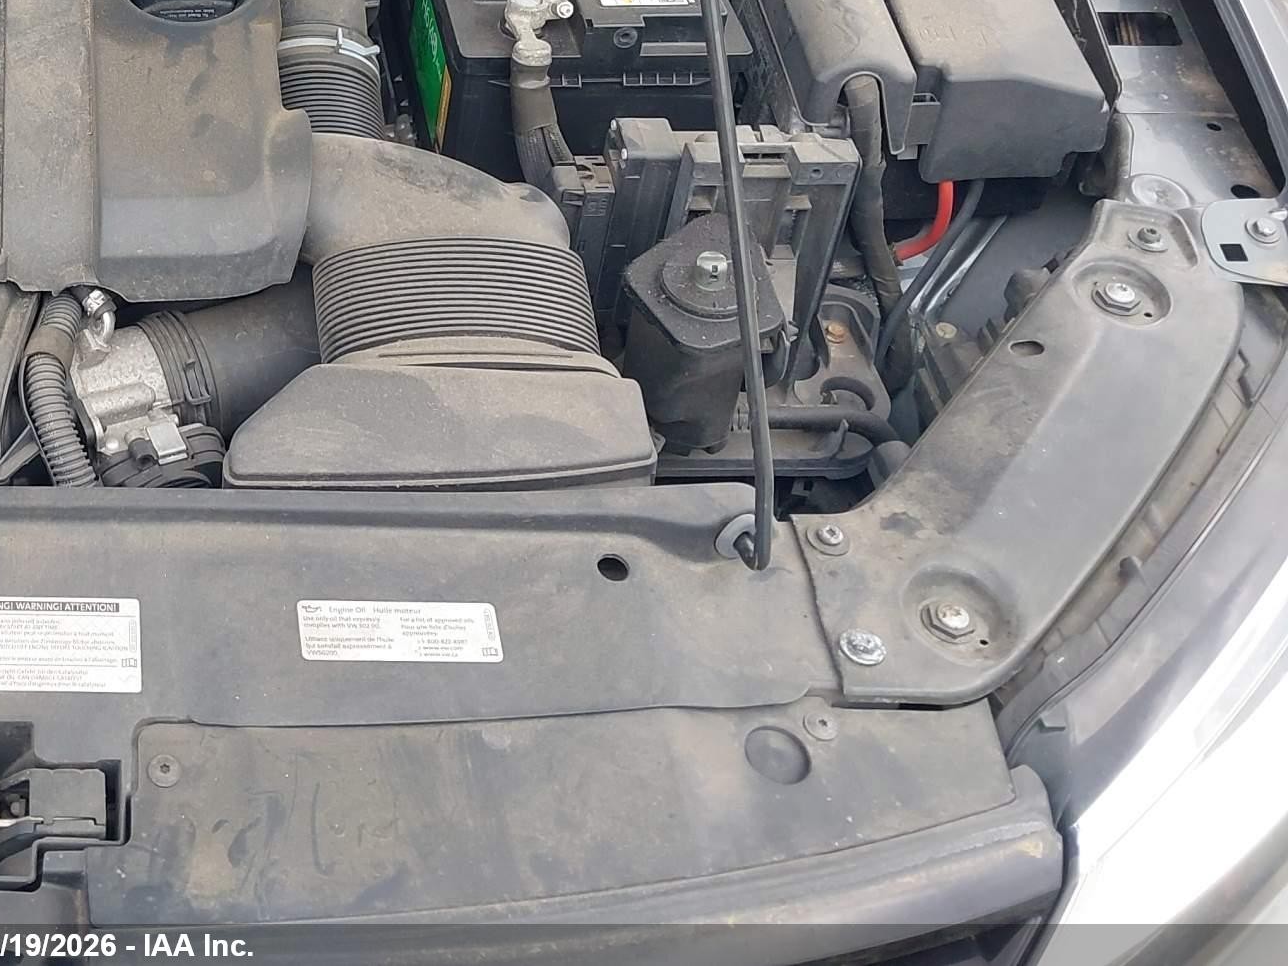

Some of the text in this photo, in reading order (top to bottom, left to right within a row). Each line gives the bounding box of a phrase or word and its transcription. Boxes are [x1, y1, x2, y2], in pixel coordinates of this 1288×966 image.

[15, 601, 63, 611] WARNING!
[64, 602, 117, 612] ATTENTION!
[328, 606, 354, 614] Engine
